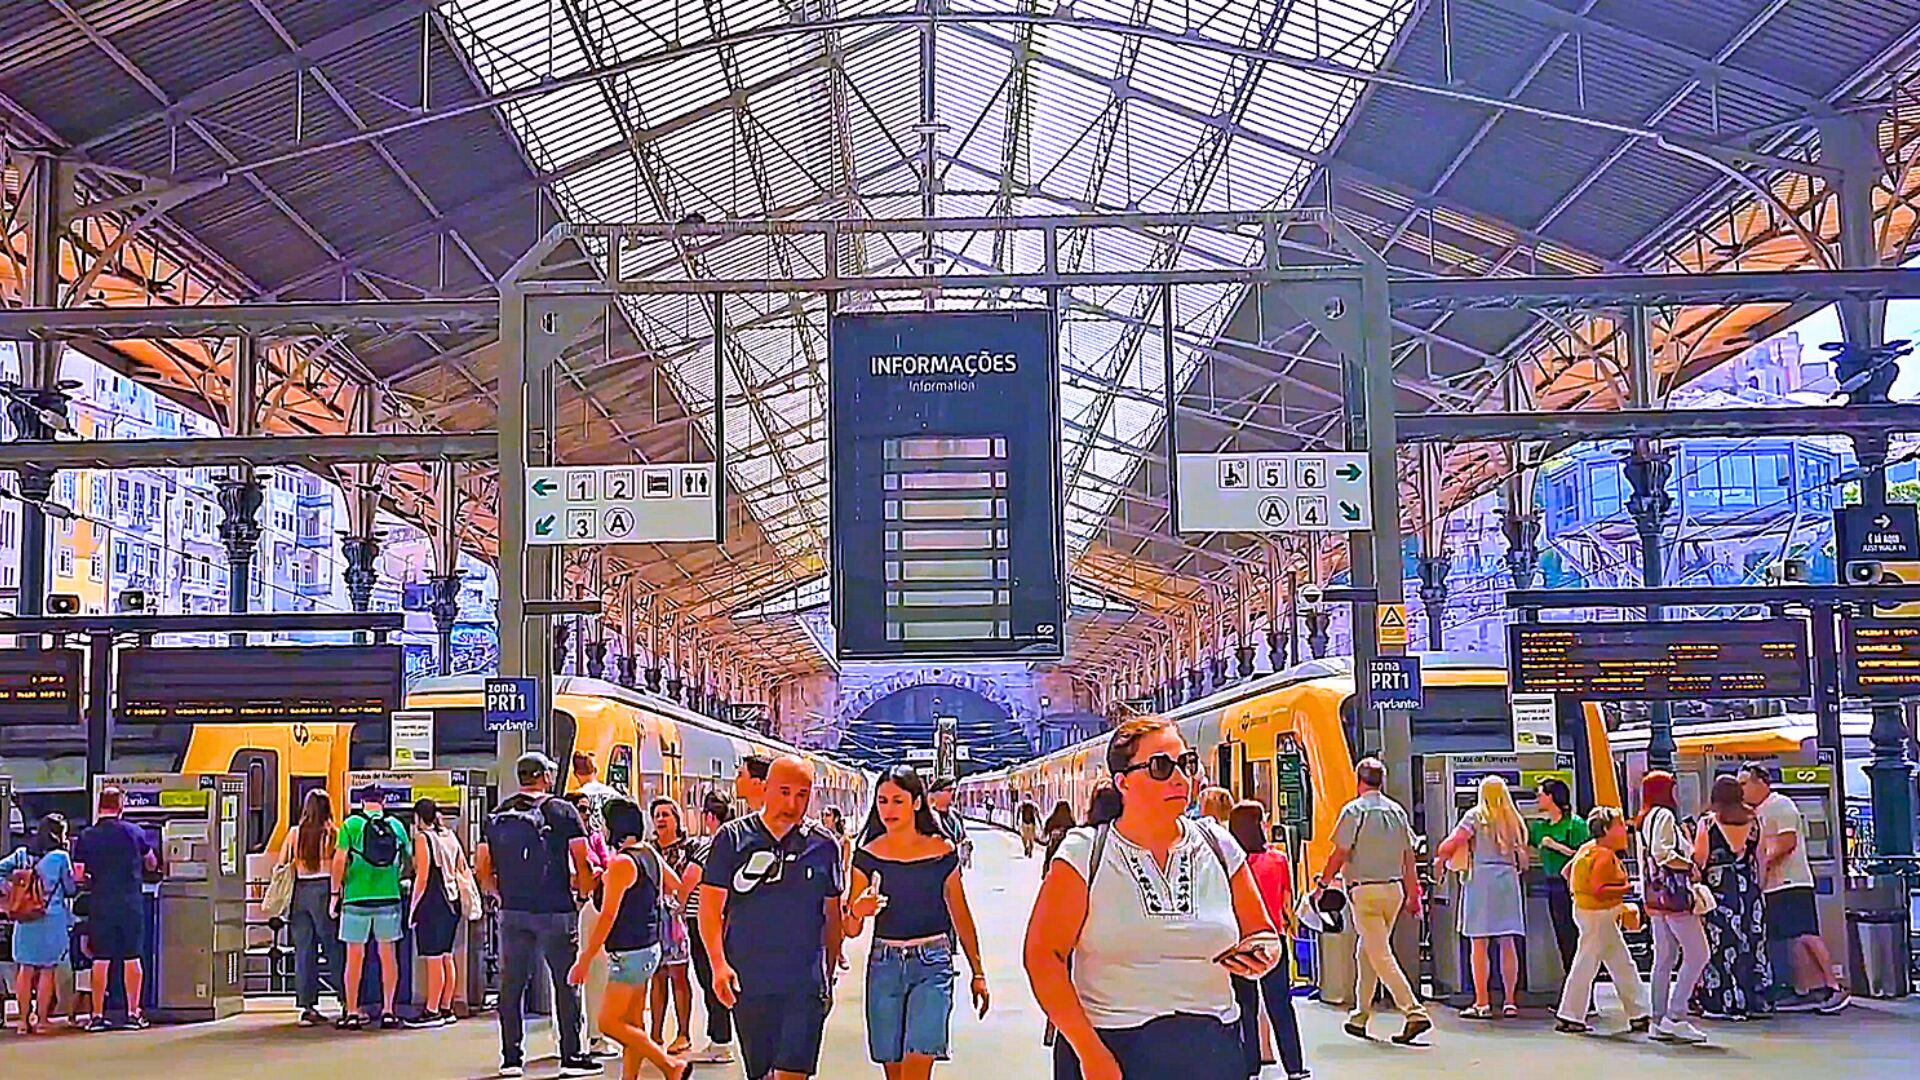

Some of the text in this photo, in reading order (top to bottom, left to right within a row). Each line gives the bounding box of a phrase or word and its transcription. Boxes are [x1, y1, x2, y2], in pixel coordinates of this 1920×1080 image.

[871, 350, 1017, 377] INFORMAÇÕES
[909, 380, 975, 393] Information
[1267, 468, 1279, 487] 5
[1304, 468, 1316, 487] 6
[577, 481, 586, 500] 1
[613, 480, 626, 499] 2
[1265, 503, 1282, 521] A
[1304, 506, 1318, 524] 4
[577, 519, 588, 538] 3
[610, 513, 627, 532] A
[1371, 662, 1400, 671] zona
[488, 683, 517, 693] zona
[1371, 672, 1409, 690] PRT1
[488, 694, 525, 711] PRT1
[1372, 698, 1420, 710] andante
[488, 719, 534, 731] andante
